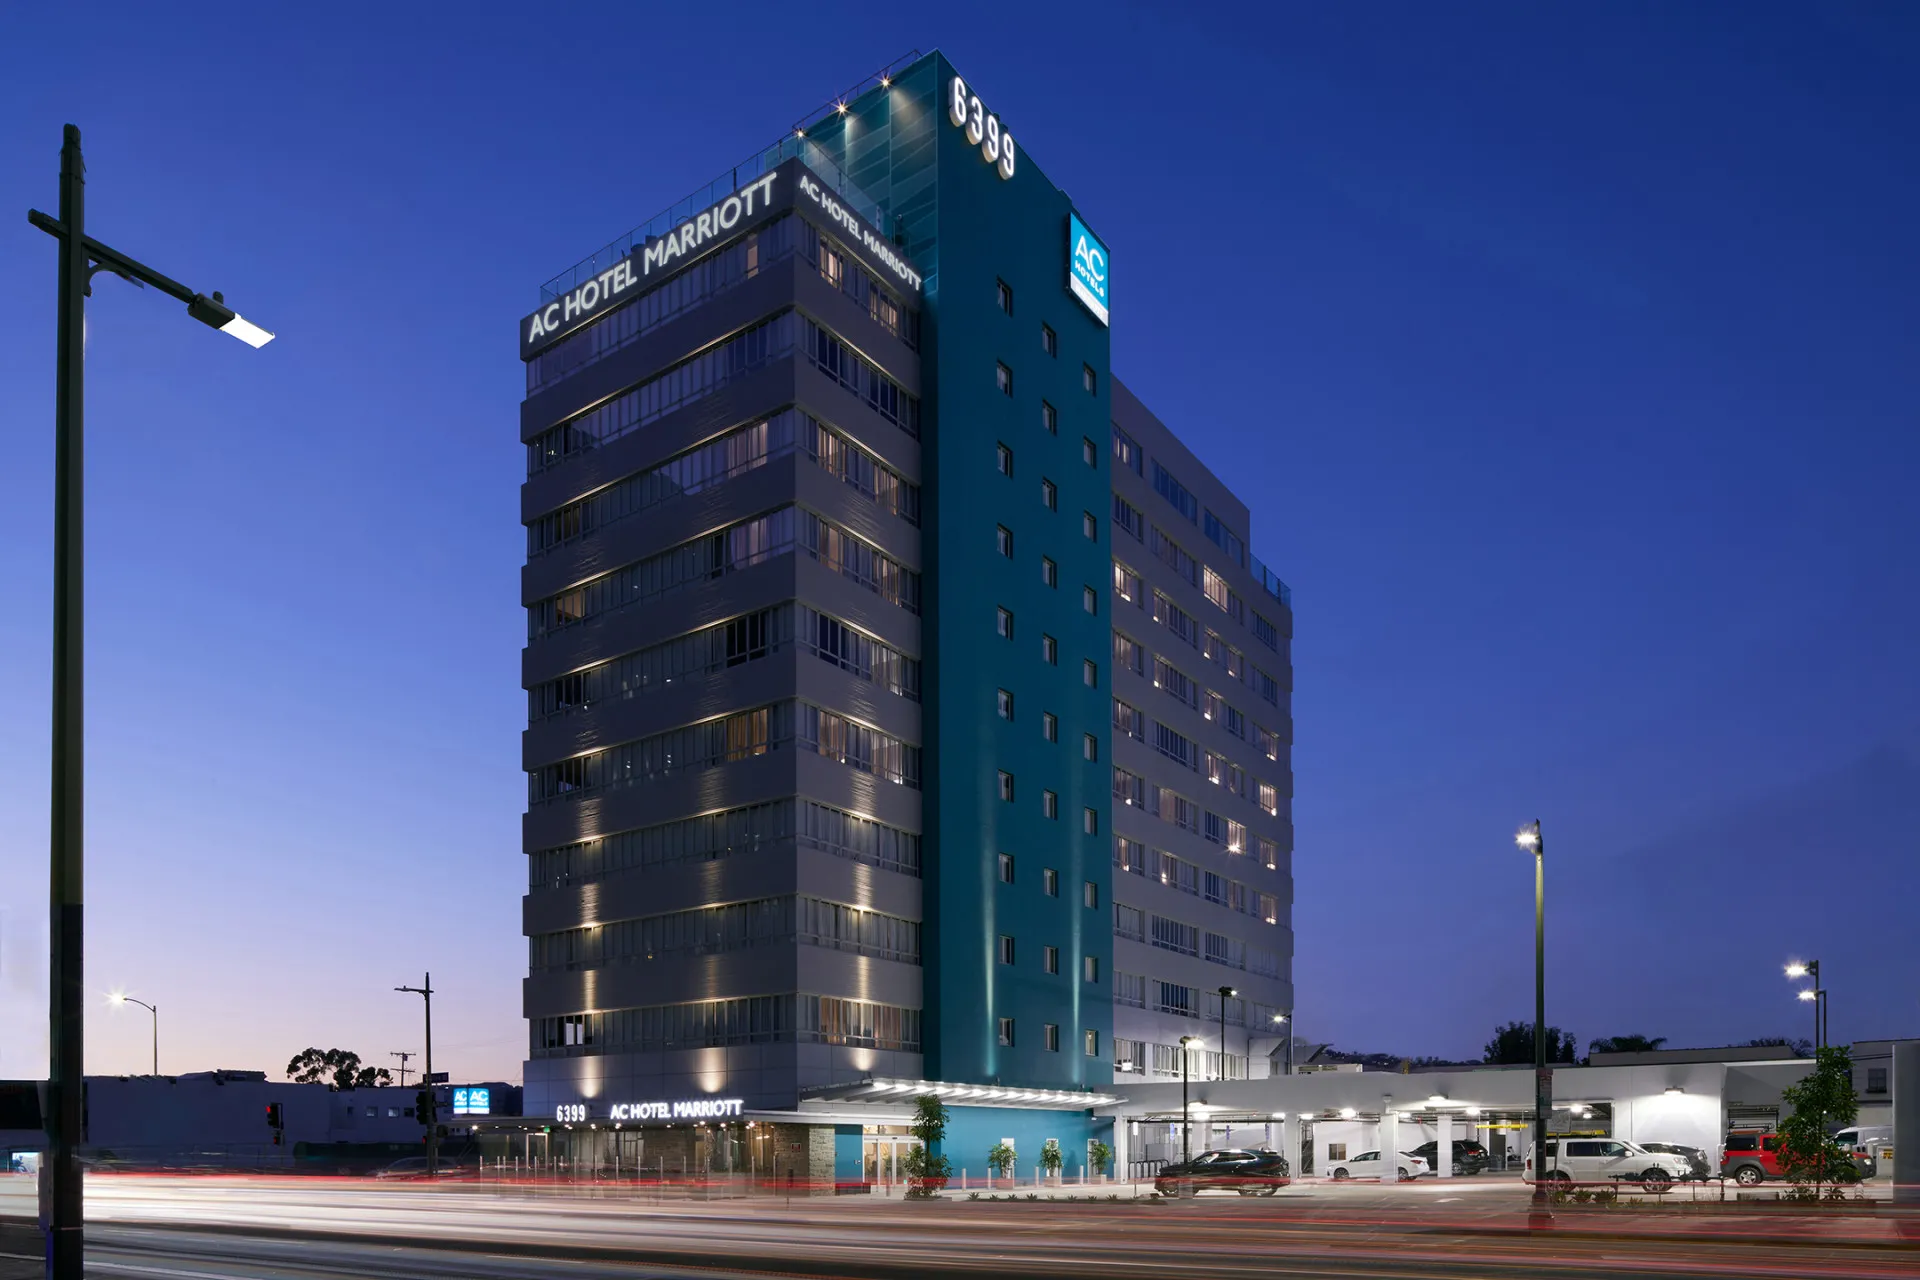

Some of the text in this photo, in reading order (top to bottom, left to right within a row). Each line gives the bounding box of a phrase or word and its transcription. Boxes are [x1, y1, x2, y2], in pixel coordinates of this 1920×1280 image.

[951, 76, 1015, 179] 6399
[800, 176, 922, 291] AC HOTEL MARRIOTT
[528, 172, 777, 343] AC HOTEL MARRIOTT
[1075, 235, 1104, 282] AC
[1074, 260, 1105, 297] HOTELS
[455, 1091, 467, 1101] AC
[470, 1091, 488, 1101] AC
[556, 1104, 586, 1122] 6399
[610, 1099, 744, 1120] AC HOTEL MARRIOTT
